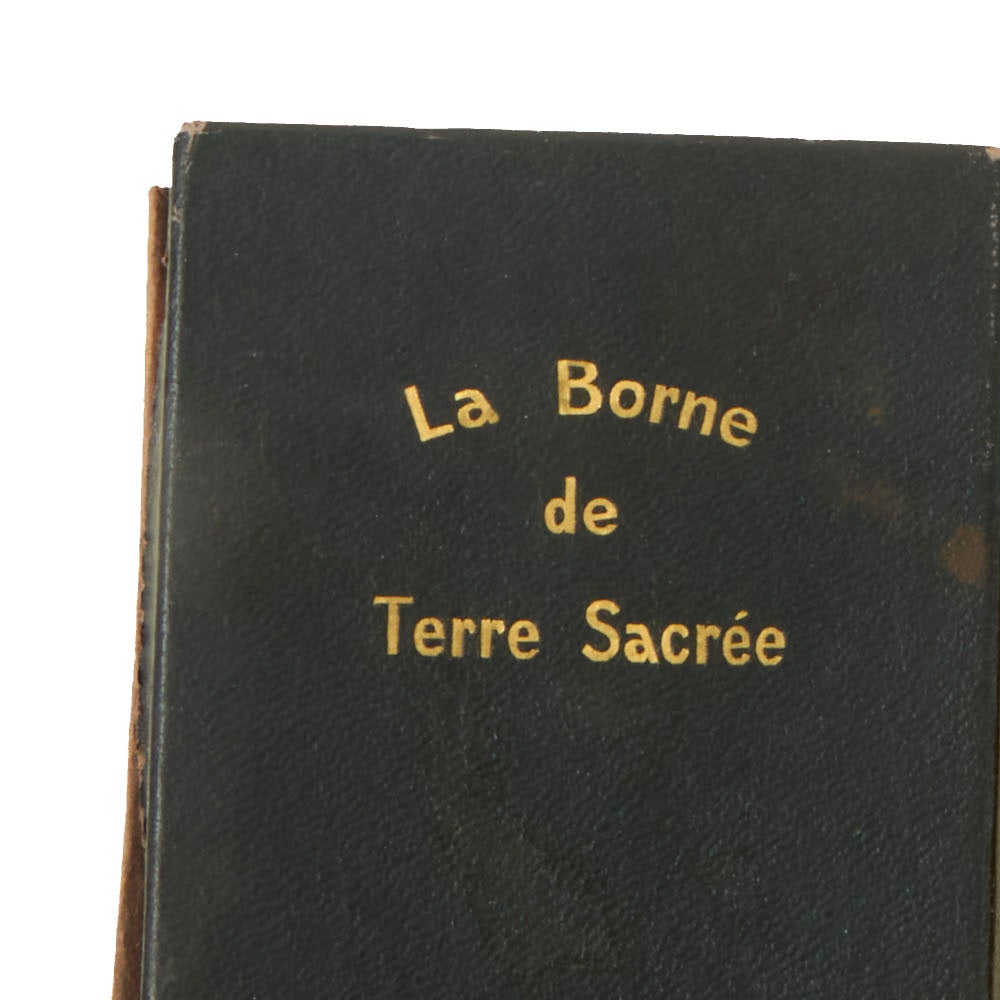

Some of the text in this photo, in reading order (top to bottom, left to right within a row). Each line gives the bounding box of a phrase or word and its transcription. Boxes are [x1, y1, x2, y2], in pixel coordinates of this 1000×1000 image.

[404, 358, 758, 447] La Borne
[544, 475, 619, 536] de
[373, 595, 787, 666] Terre Sacrée
